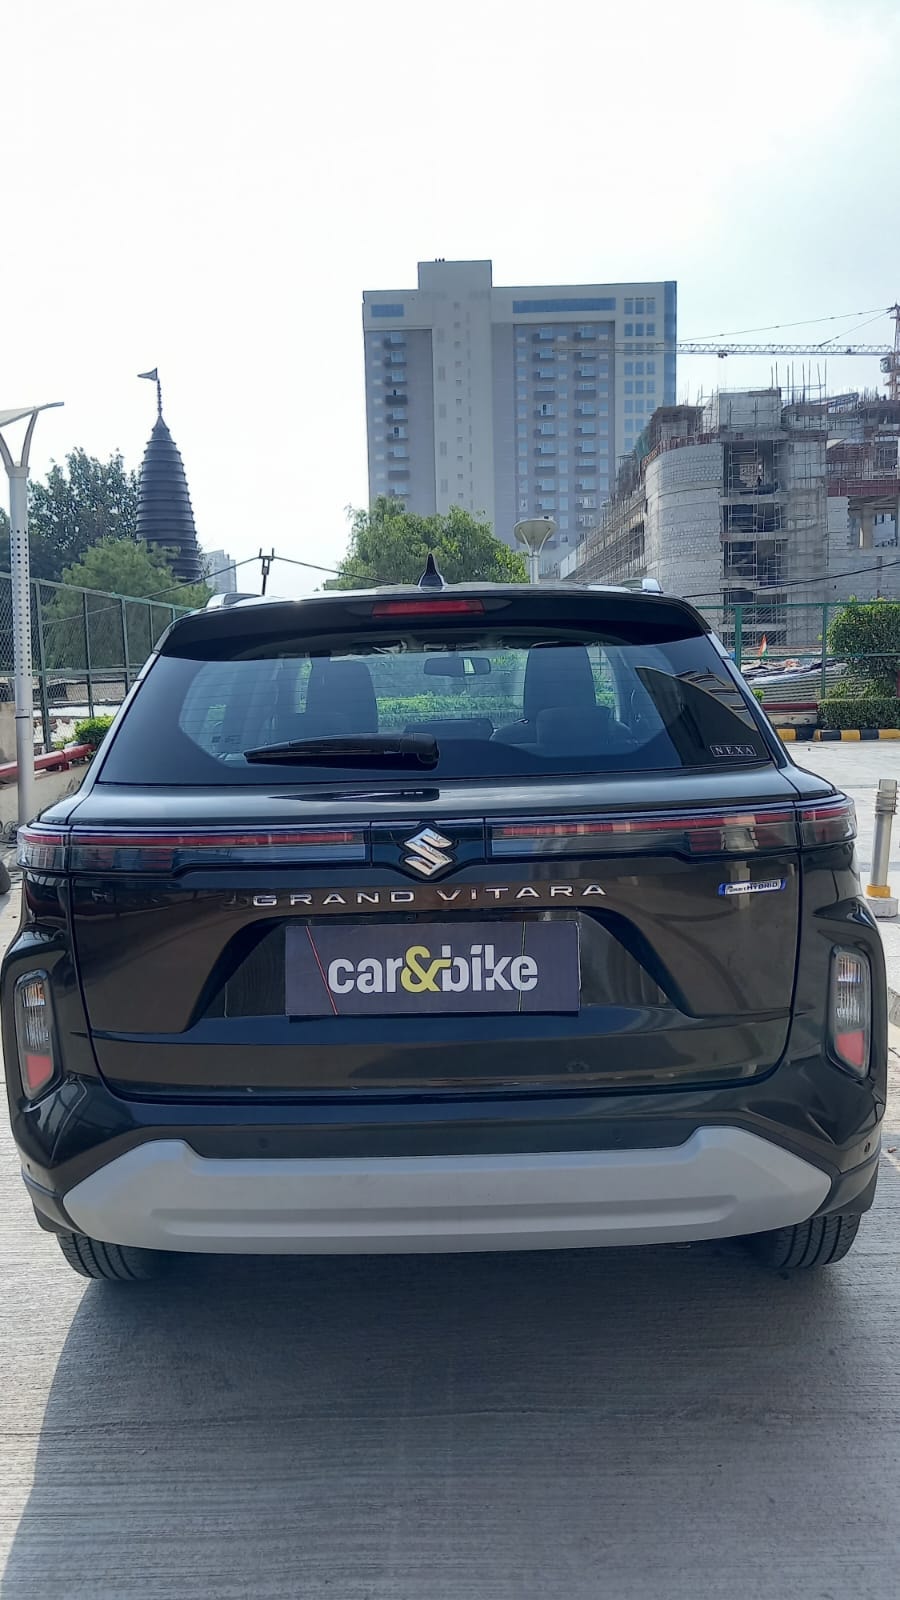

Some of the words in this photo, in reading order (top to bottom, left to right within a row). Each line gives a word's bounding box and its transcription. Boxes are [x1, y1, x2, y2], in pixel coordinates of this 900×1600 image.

[714, 746, 754, 755] NEXA
[253, 890, 415, 906] GRAND
[436, 884, 607, 901] VITARA
[328, 944, 538, 994] car&bike
